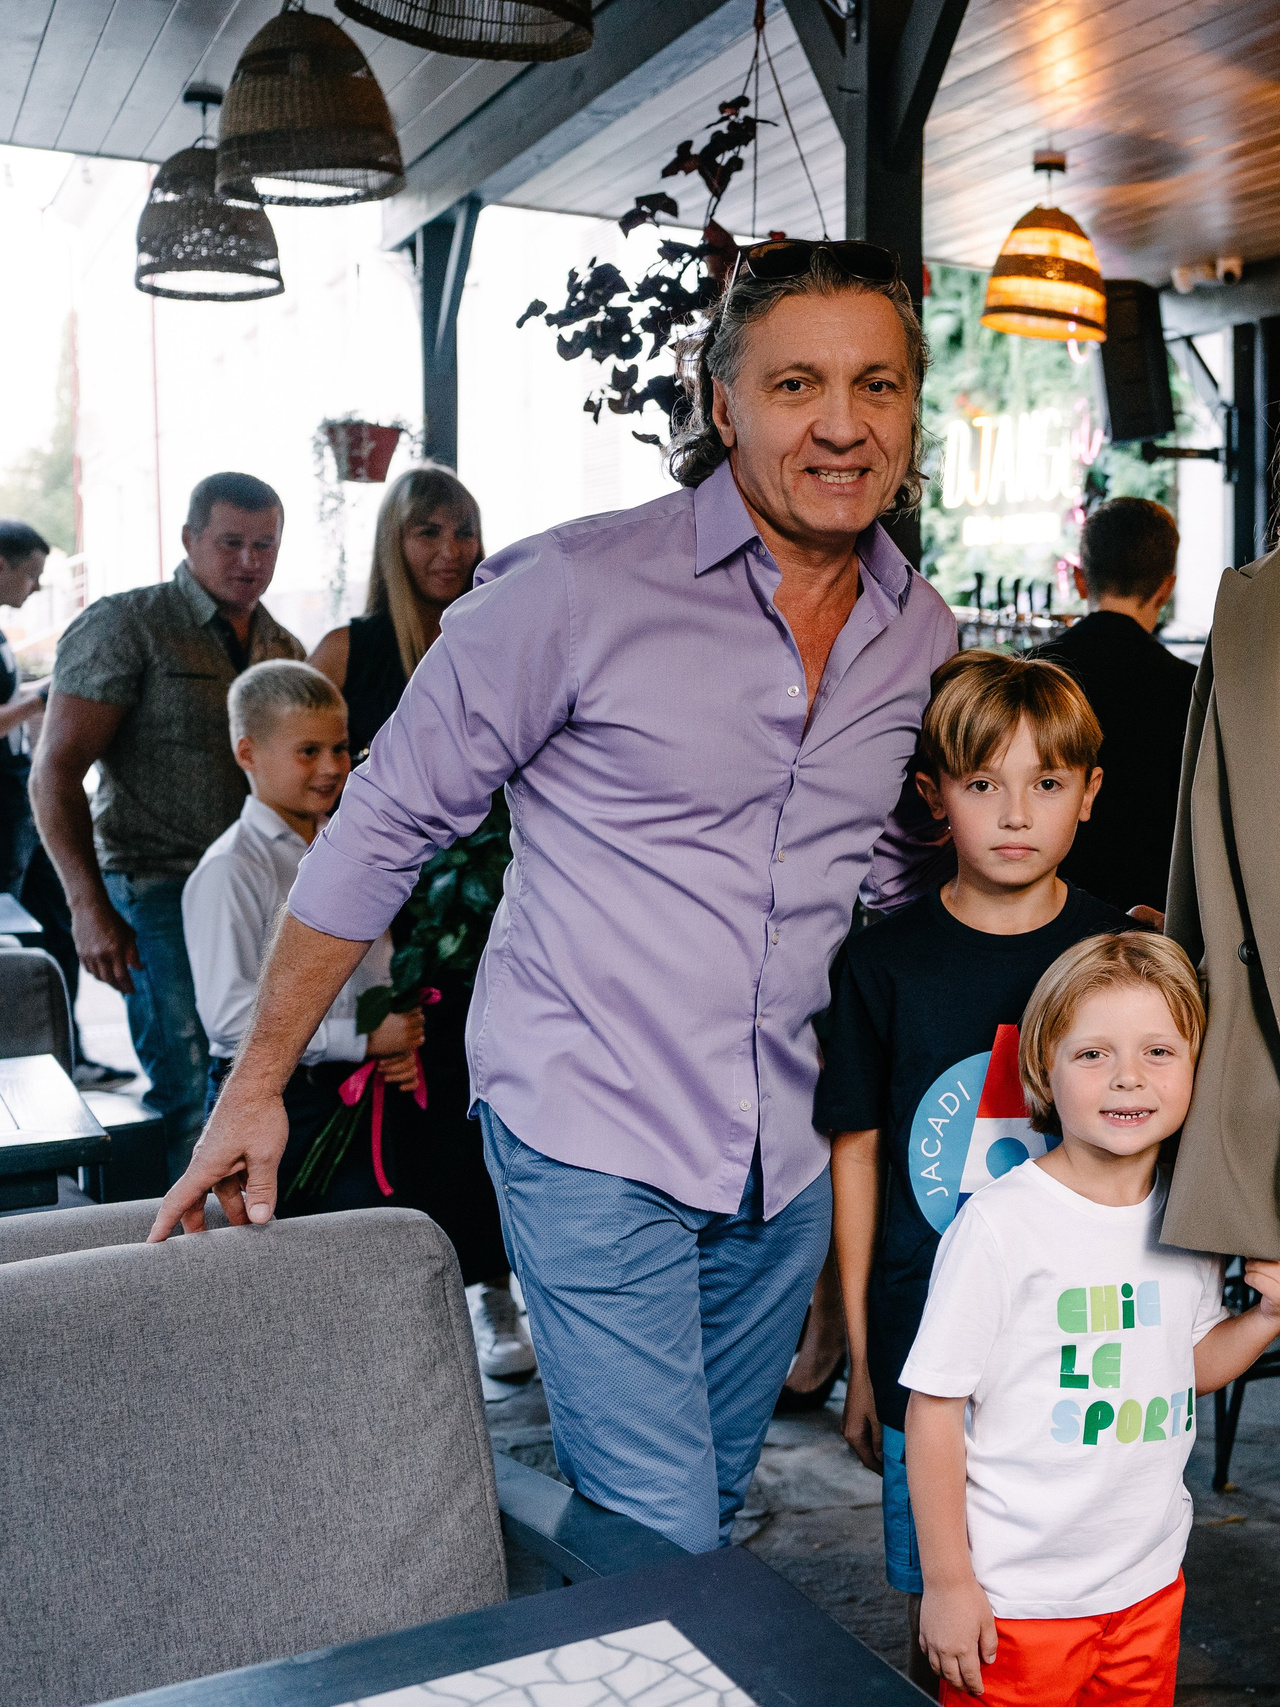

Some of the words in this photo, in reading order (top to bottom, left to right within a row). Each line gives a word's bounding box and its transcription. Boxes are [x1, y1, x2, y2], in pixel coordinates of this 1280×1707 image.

[919, 1080, 973, 1199] JACADI
[1059, 1342, 1122, 1390] LE
[1050, 1386, 1195, 1446] SPORT!
